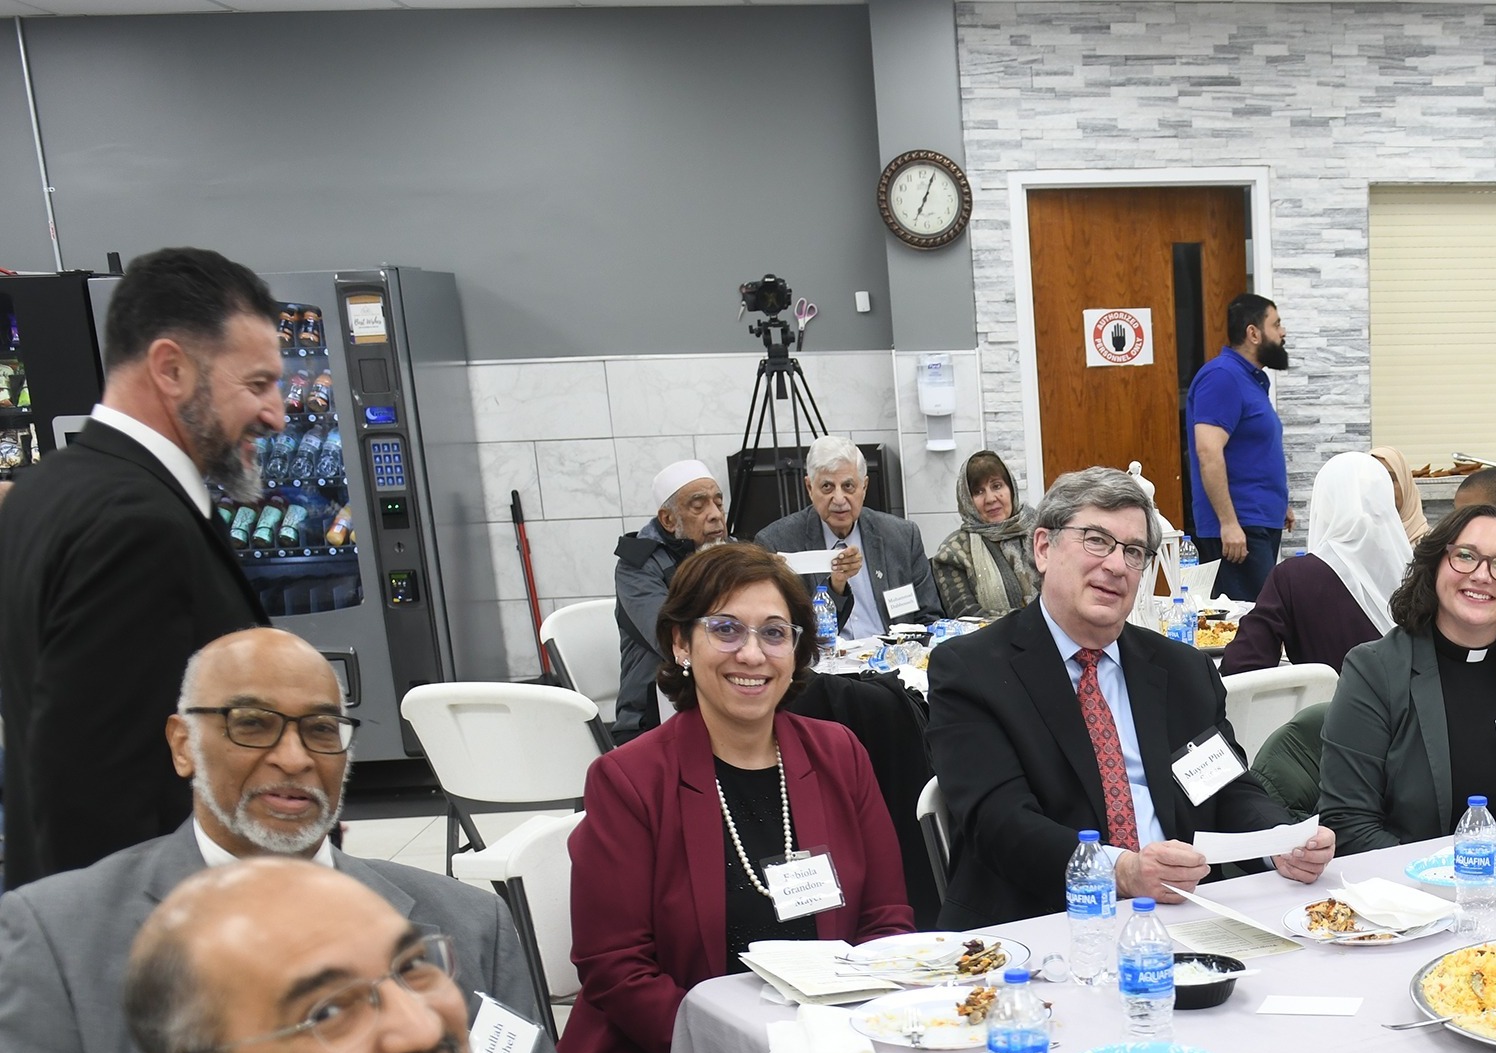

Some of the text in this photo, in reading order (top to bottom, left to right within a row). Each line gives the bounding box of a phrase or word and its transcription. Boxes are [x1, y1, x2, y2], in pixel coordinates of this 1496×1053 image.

[906, 174, 912, 182] 11
[918, 170, 927, 179] 12
[942, 181, 948, 190] 2
[896, 197, 902, 205] 9
[948, 194, 953, 203] 3
[924, 221, 930, 229] 6
[937, 216, 943, 225] 5
[1097, 312, 1139, 330] AUTHORIZED
[1095, 337, 1142, 362] PERSONNEL ONLY
[1184, 761, 1209, 779] Mayor
[1208, 749, 1225, 762] Phil
[1455, 855, 1491, 866] AQUAFINA
[783, 881, 825, 896] Grandon-
[1066, 891, 1097, 905] QUAFINA
